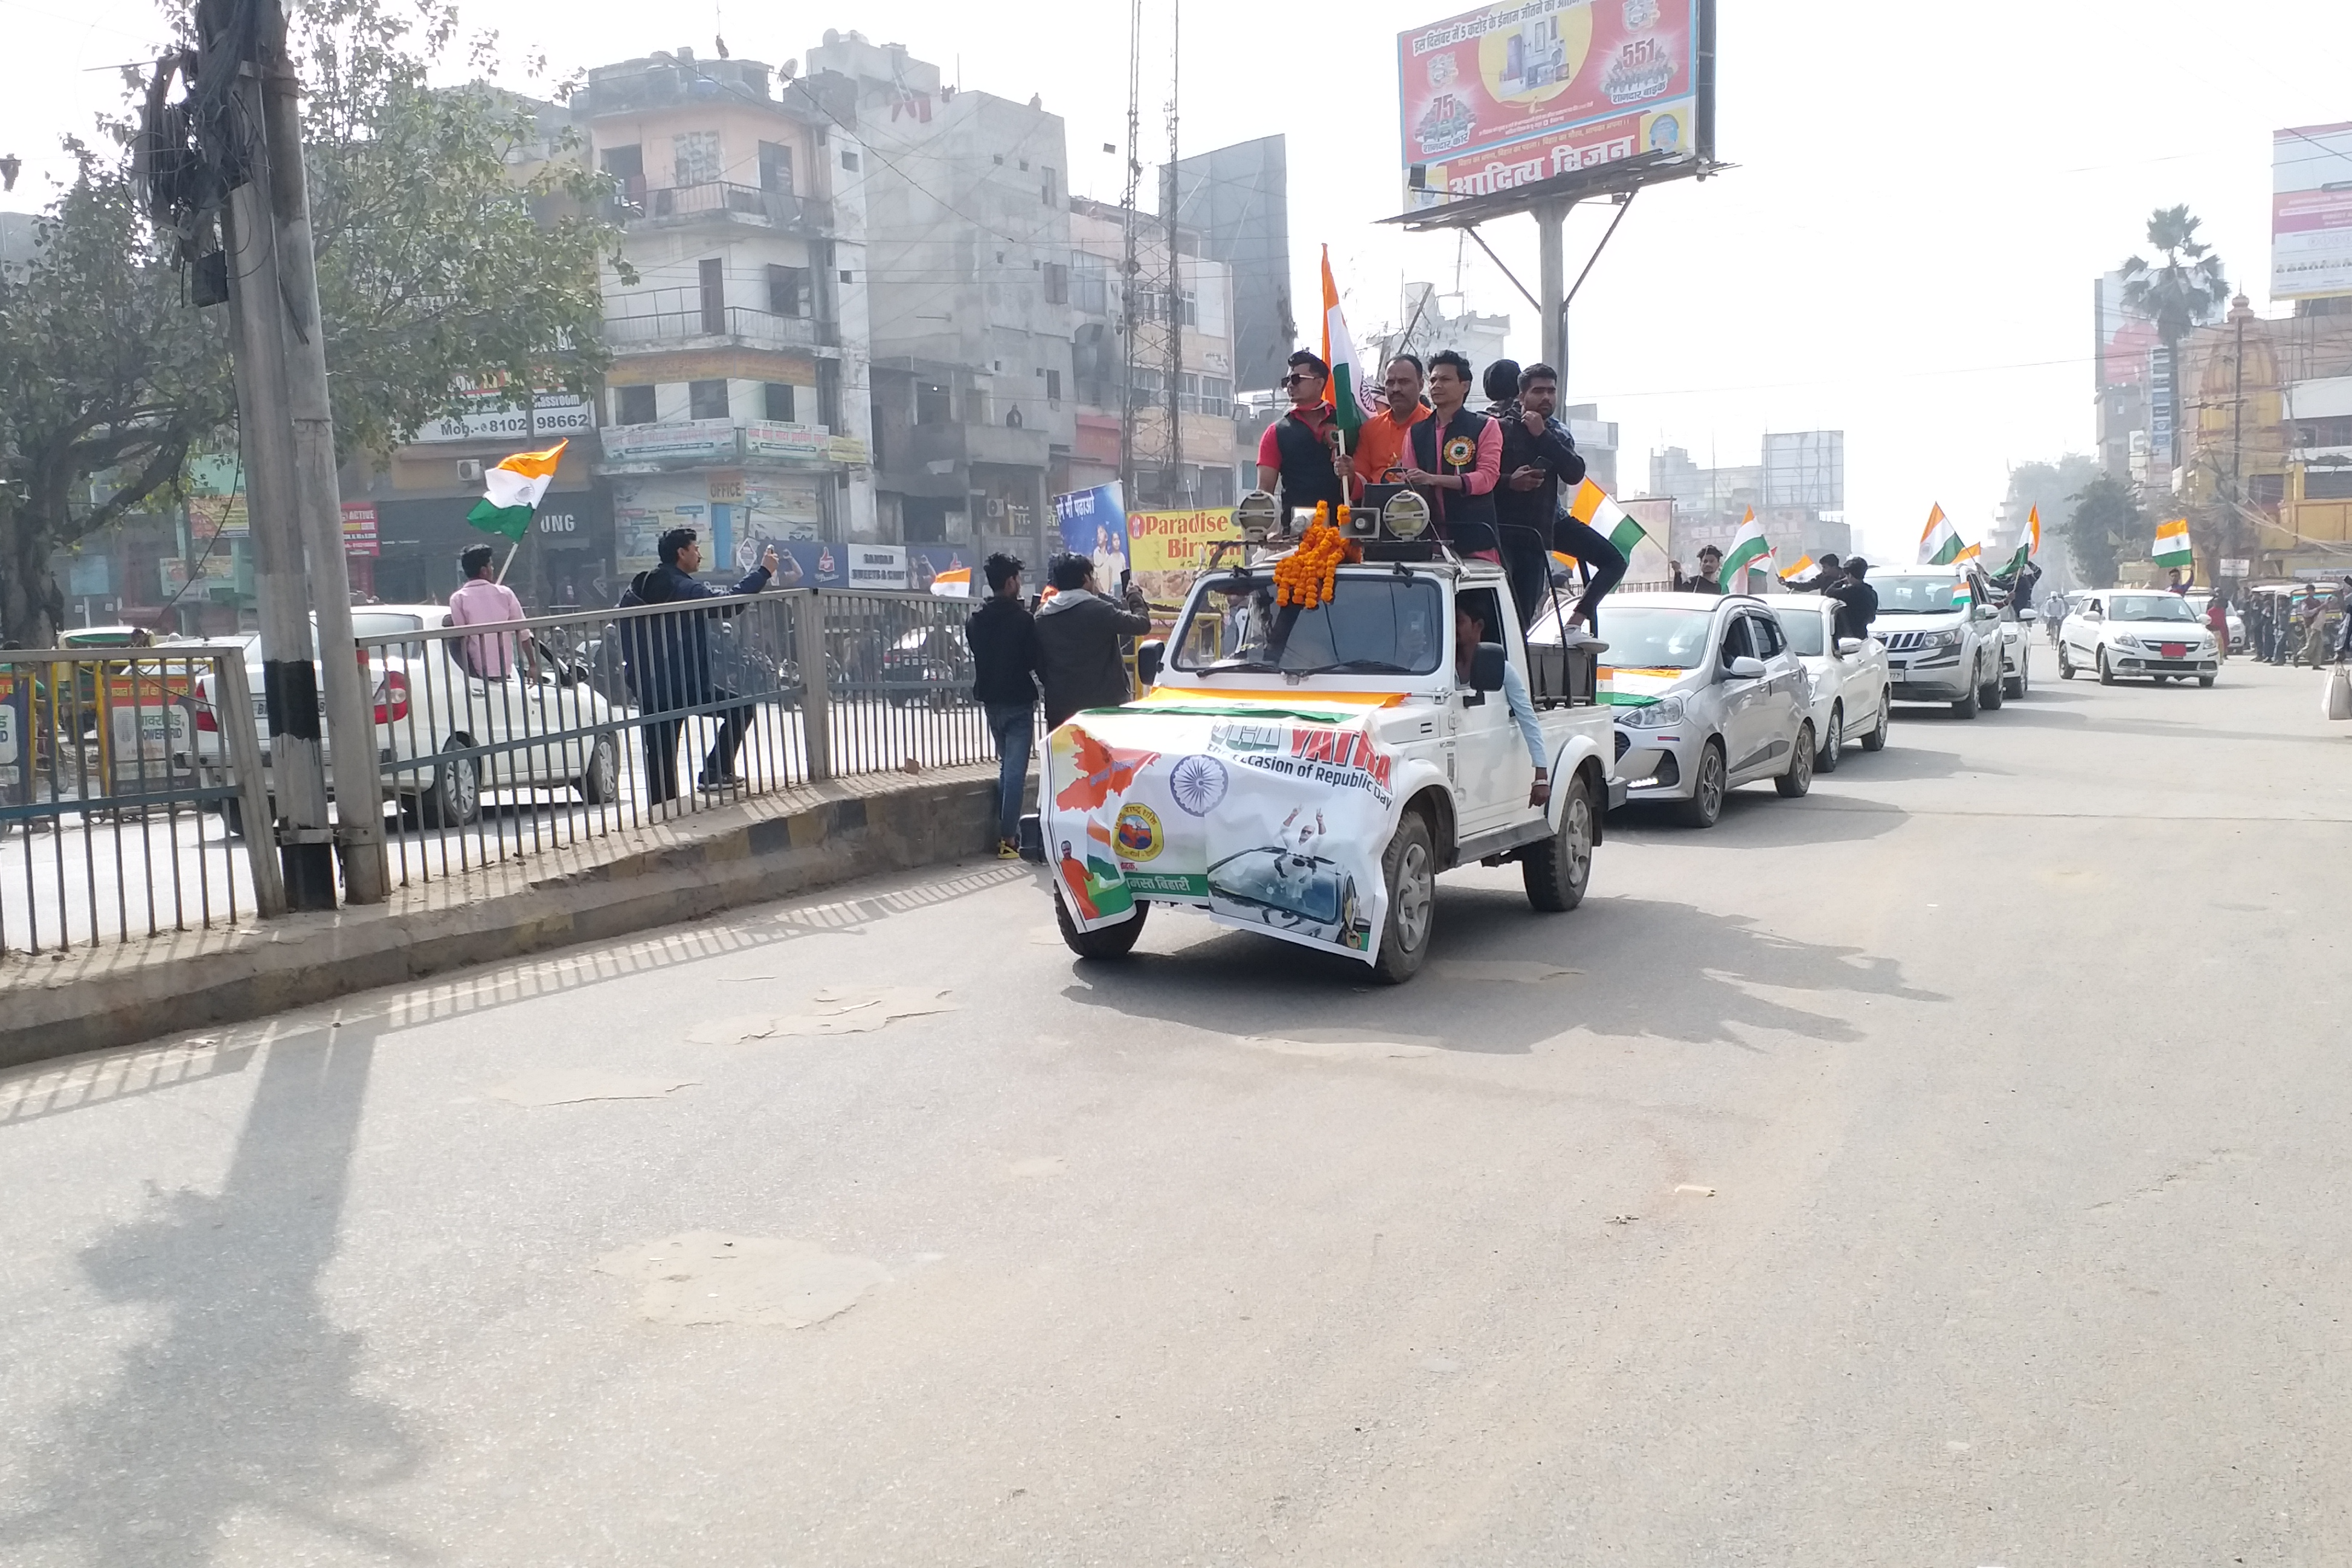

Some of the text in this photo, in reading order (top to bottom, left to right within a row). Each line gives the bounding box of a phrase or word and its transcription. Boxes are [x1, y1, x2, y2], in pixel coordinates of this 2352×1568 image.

[1414, 38, 1426, 53] इस
[1452, 24, 1461, 40] में
[1462, 27, 1466, 39] 5
[1468, 21, 1487, 36] करोड़
[1488, 15, 1496, 30] के
[1497, 10, 1519, 28] ईनाम
[1520, 2, 1543, 20] जीतने
[1623, 38, 1655, 68] 551
[1433, 94, 1455, 122] 75
[1449, 134, 1635, 203] आदित्य विजन
[537, 414, 588, 429] 98662
[711, 482, 742, 498] OFFICE
[1146, 512, 1228, 535] Paradise
[1290, 725, 1393, 795] YATRA
[1296, 763, 1313, 778] of
[1315, 766, 1374, 792] Republic
[1374, 785, 1392, 812] Day
[1155, 875, 1191, 892] बिहारी
